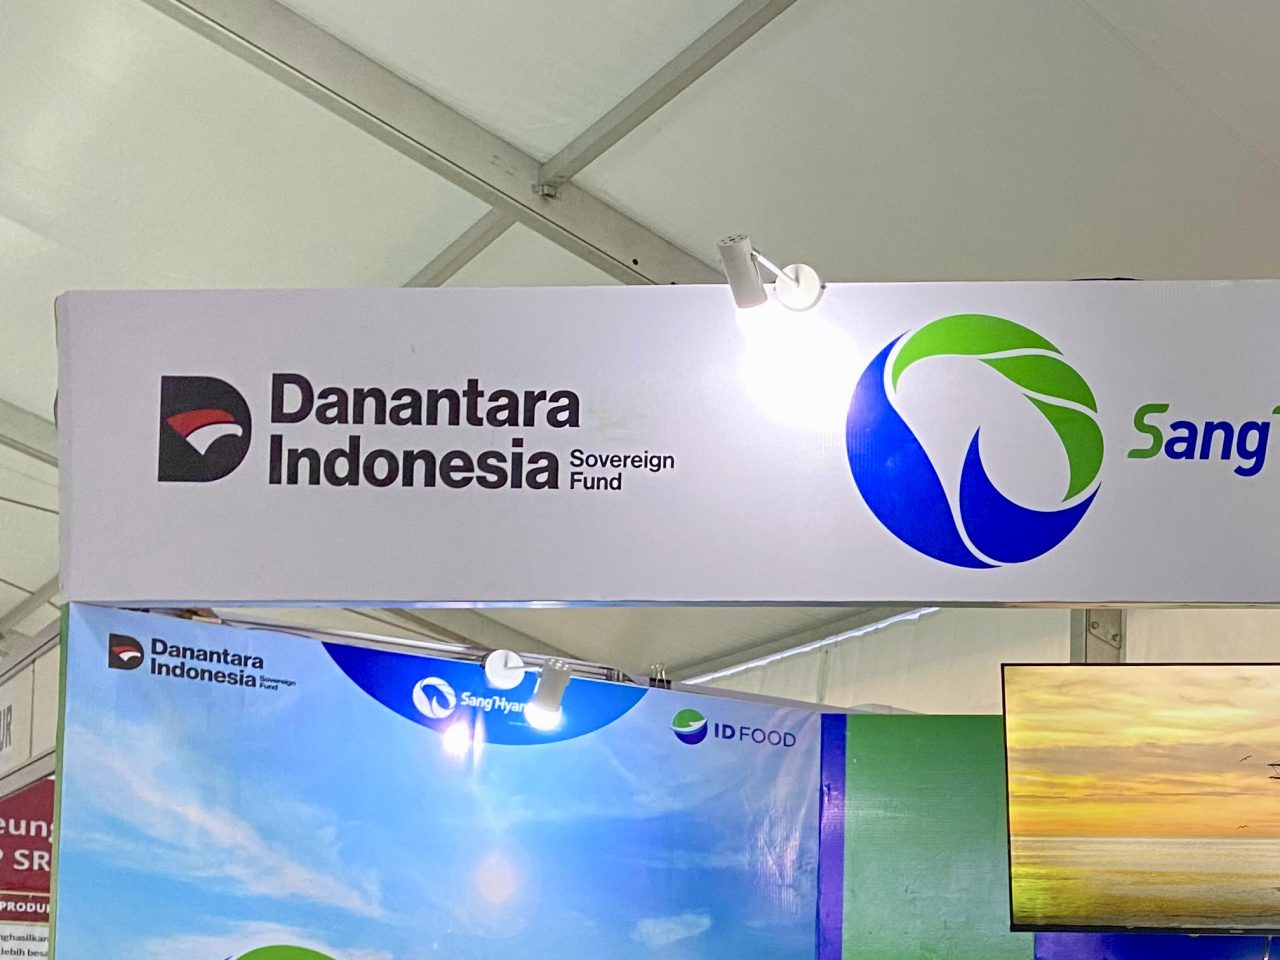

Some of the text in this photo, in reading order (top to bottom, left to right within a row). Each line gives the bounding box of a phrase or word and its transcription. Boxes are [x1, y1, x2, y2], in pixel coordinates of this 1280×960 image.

[270, 373, 580, 427] Danantara
[1127, 404, 1270, 477] Sang
[268, 435, 559, 490] Indonesia
[570, 449, 675, 474] Sovereign
[569, 472, 622, 491] Fund
[151, 638, 263, 669] Danantara
[150, 658, 256, 687] Indonesia
[260, 675, 296, 687] Sovereign
[260, 683, 278, 691] Fund
[460, 692, 493, 711] Sang
[714, 723, 797, 748] ID FOOD
